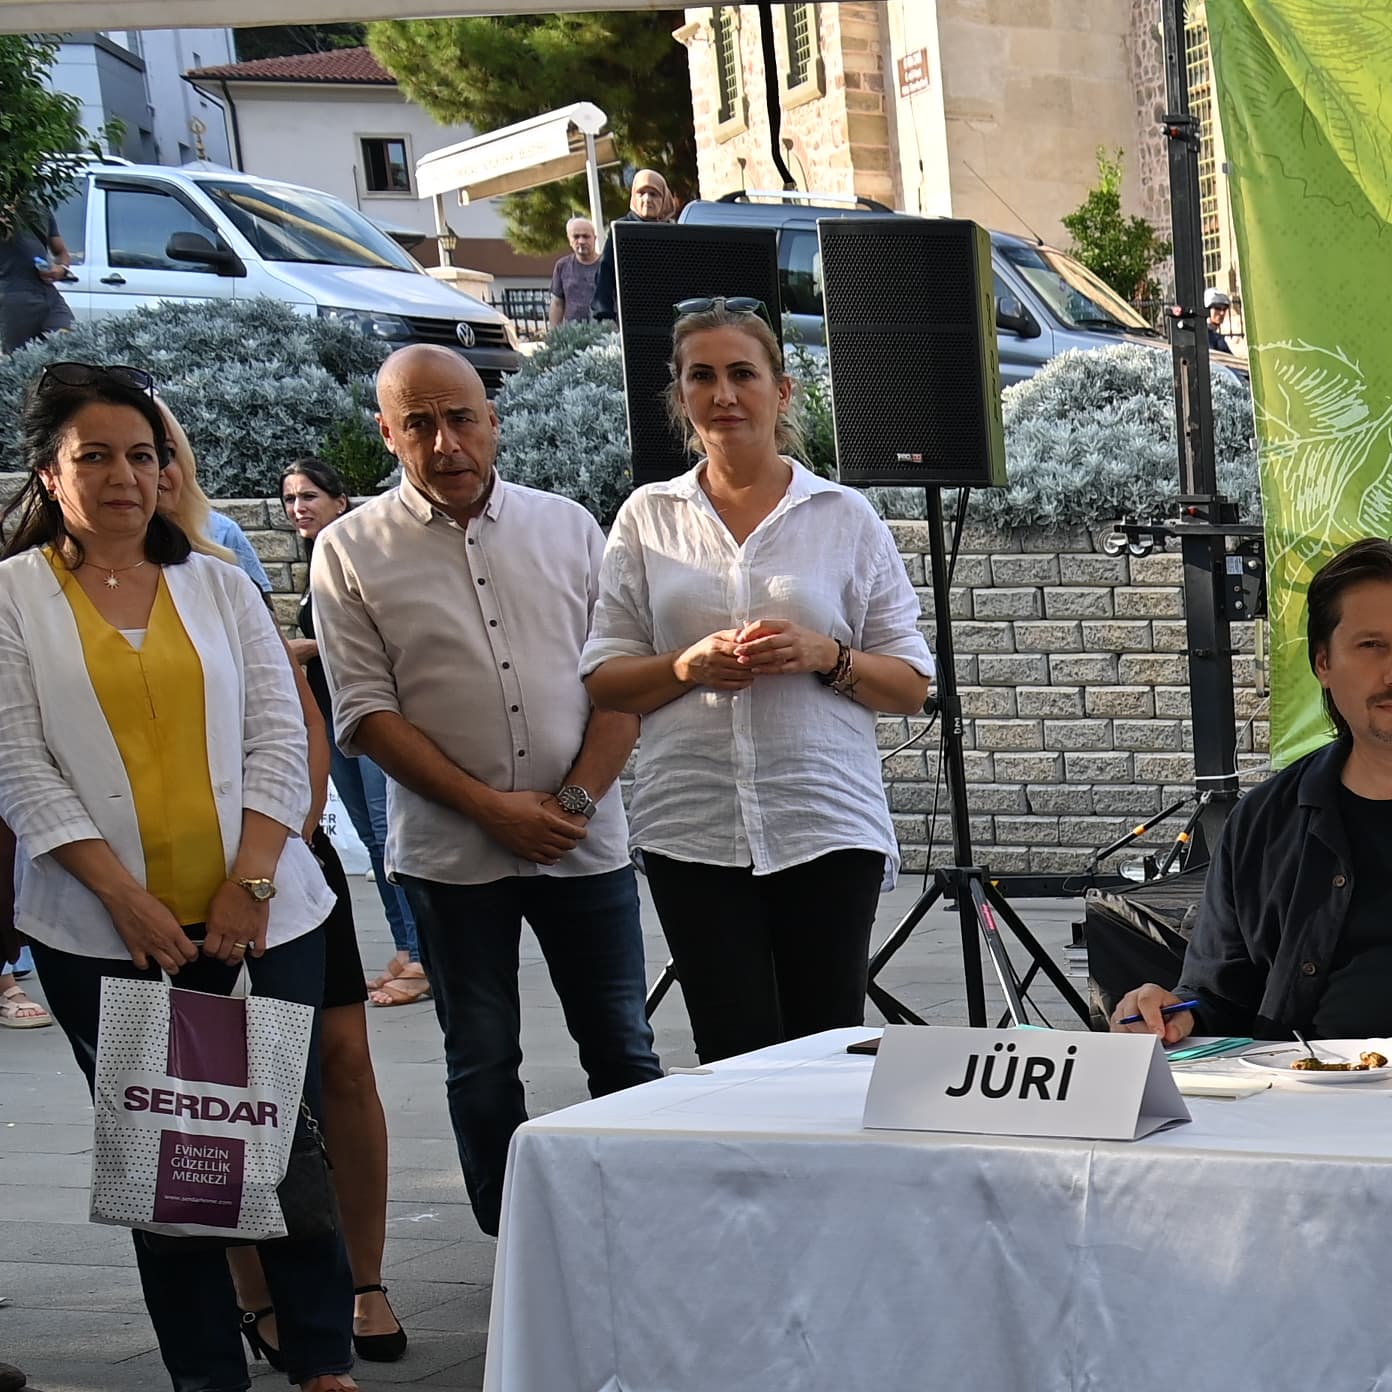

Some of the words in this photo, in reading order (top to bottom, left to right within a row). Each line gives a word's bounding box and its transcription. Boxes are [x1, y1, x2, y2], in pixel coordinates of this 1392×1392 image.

[945, 1042, 1077, 1101] JÜRİ
[123, 1085, 279, 1129] SERDAR
[174, 1143, 229, 1160] EVİNİZİN
[170, 1156, 232, 1174] GÜZELLİK
[172, 1170, 227, 1186] MERKEZİ
